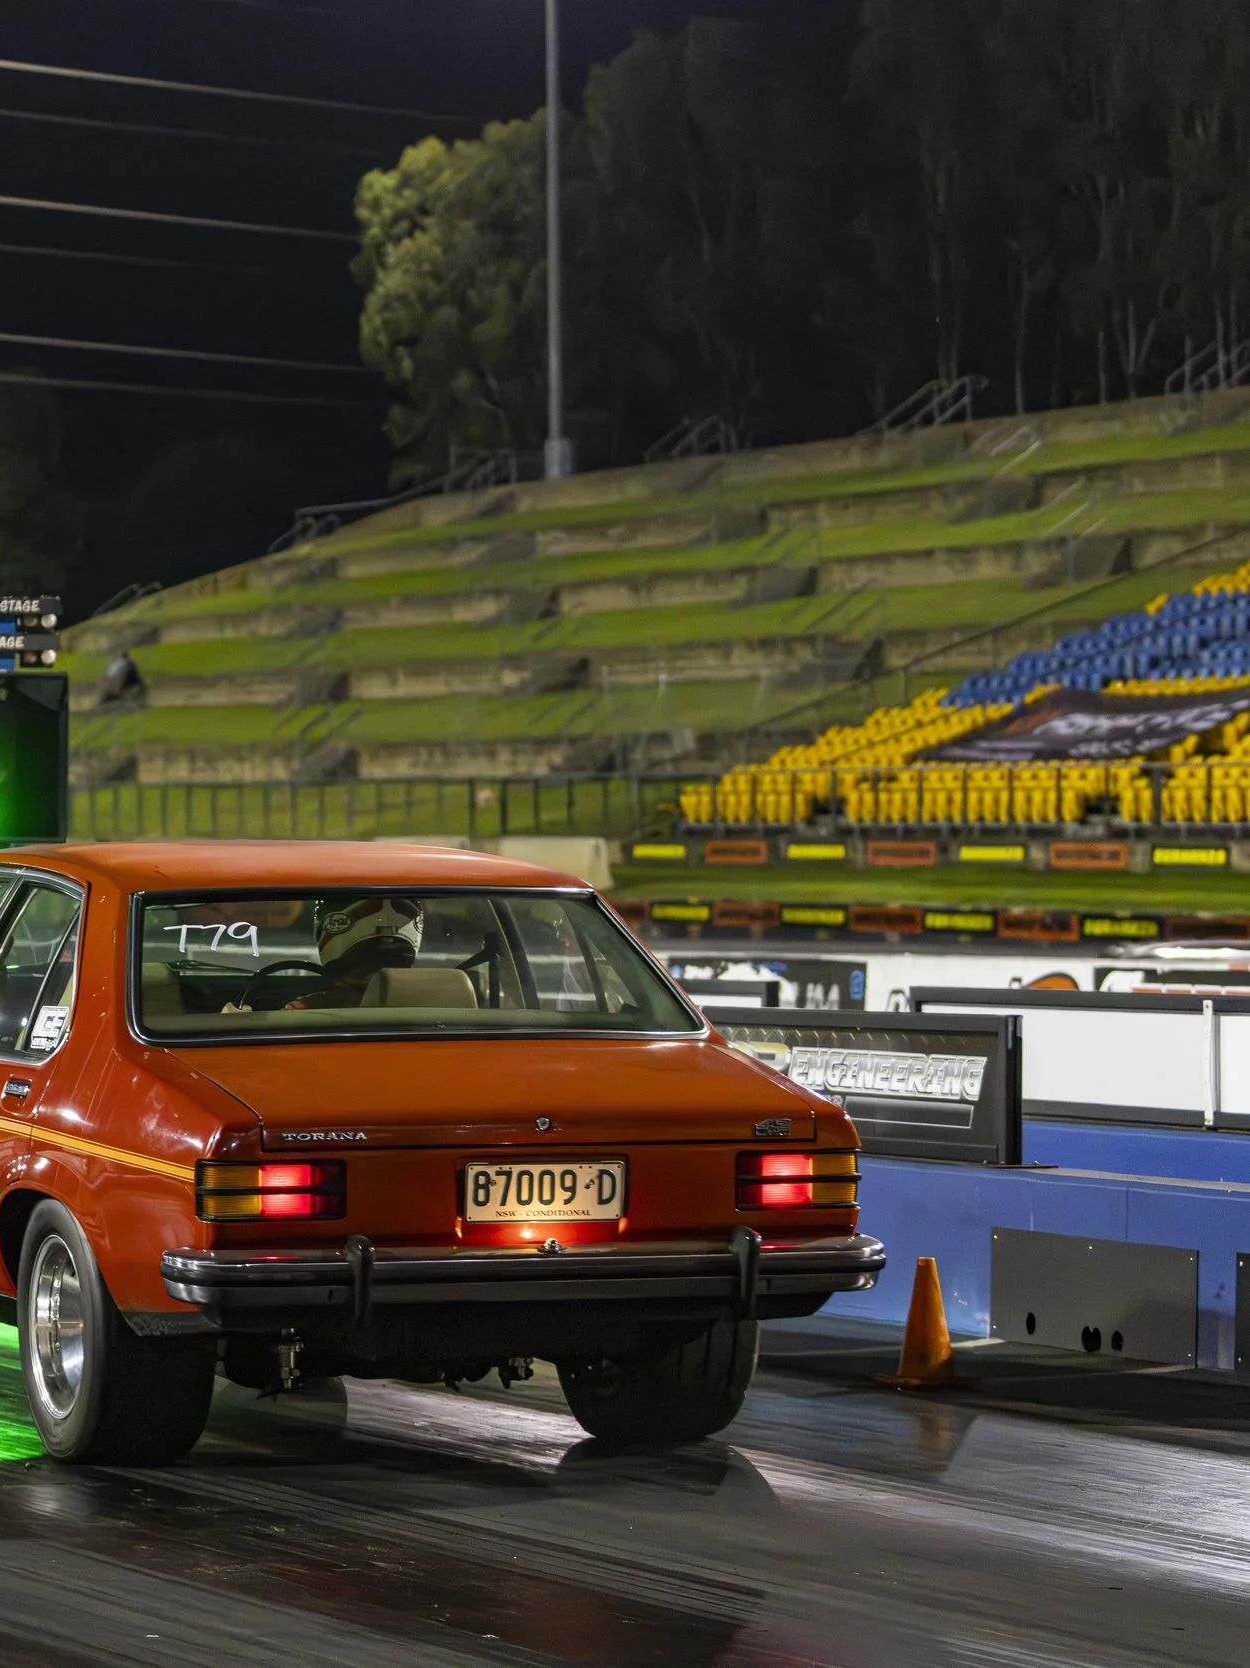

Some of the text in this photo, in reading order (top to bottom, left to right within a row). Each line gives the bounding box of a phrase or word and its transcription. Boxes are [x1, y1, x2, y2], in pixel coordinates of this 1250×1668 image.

[163, 921, 259, 957] T79
[791, 1048, 986, 1100] ENGINEERING
[282, 1131, 368, 1141] TORANA
[473, 1168, 616, 1207] 87009 D
[526, 1209, 591, 1217] CONDITIONAL
